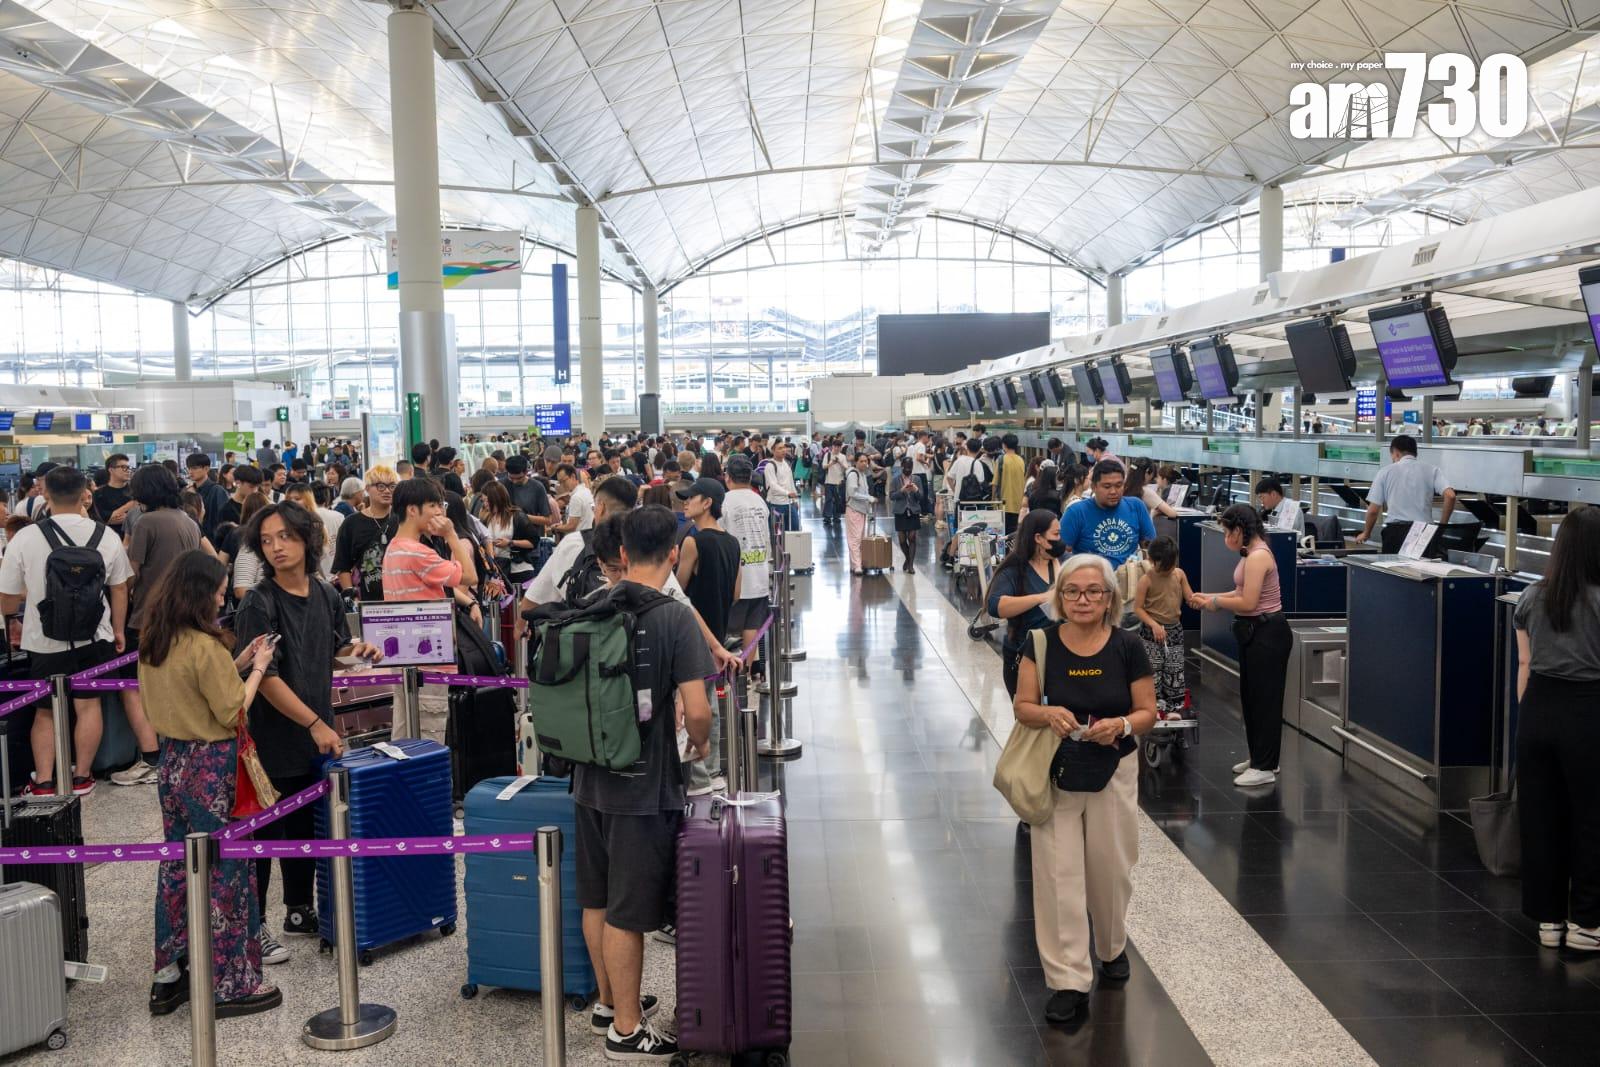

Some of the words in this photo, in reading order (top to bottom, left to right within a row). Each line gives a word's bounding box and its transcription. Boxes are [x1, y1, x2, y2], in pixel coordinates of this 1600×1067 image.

[558, 370, 567, 380] H
[1093, 518, 1116, 538] CANADA
[1117, 518, 1133, 536] WEST
[1068, 669, 1103, 677] MANGO
